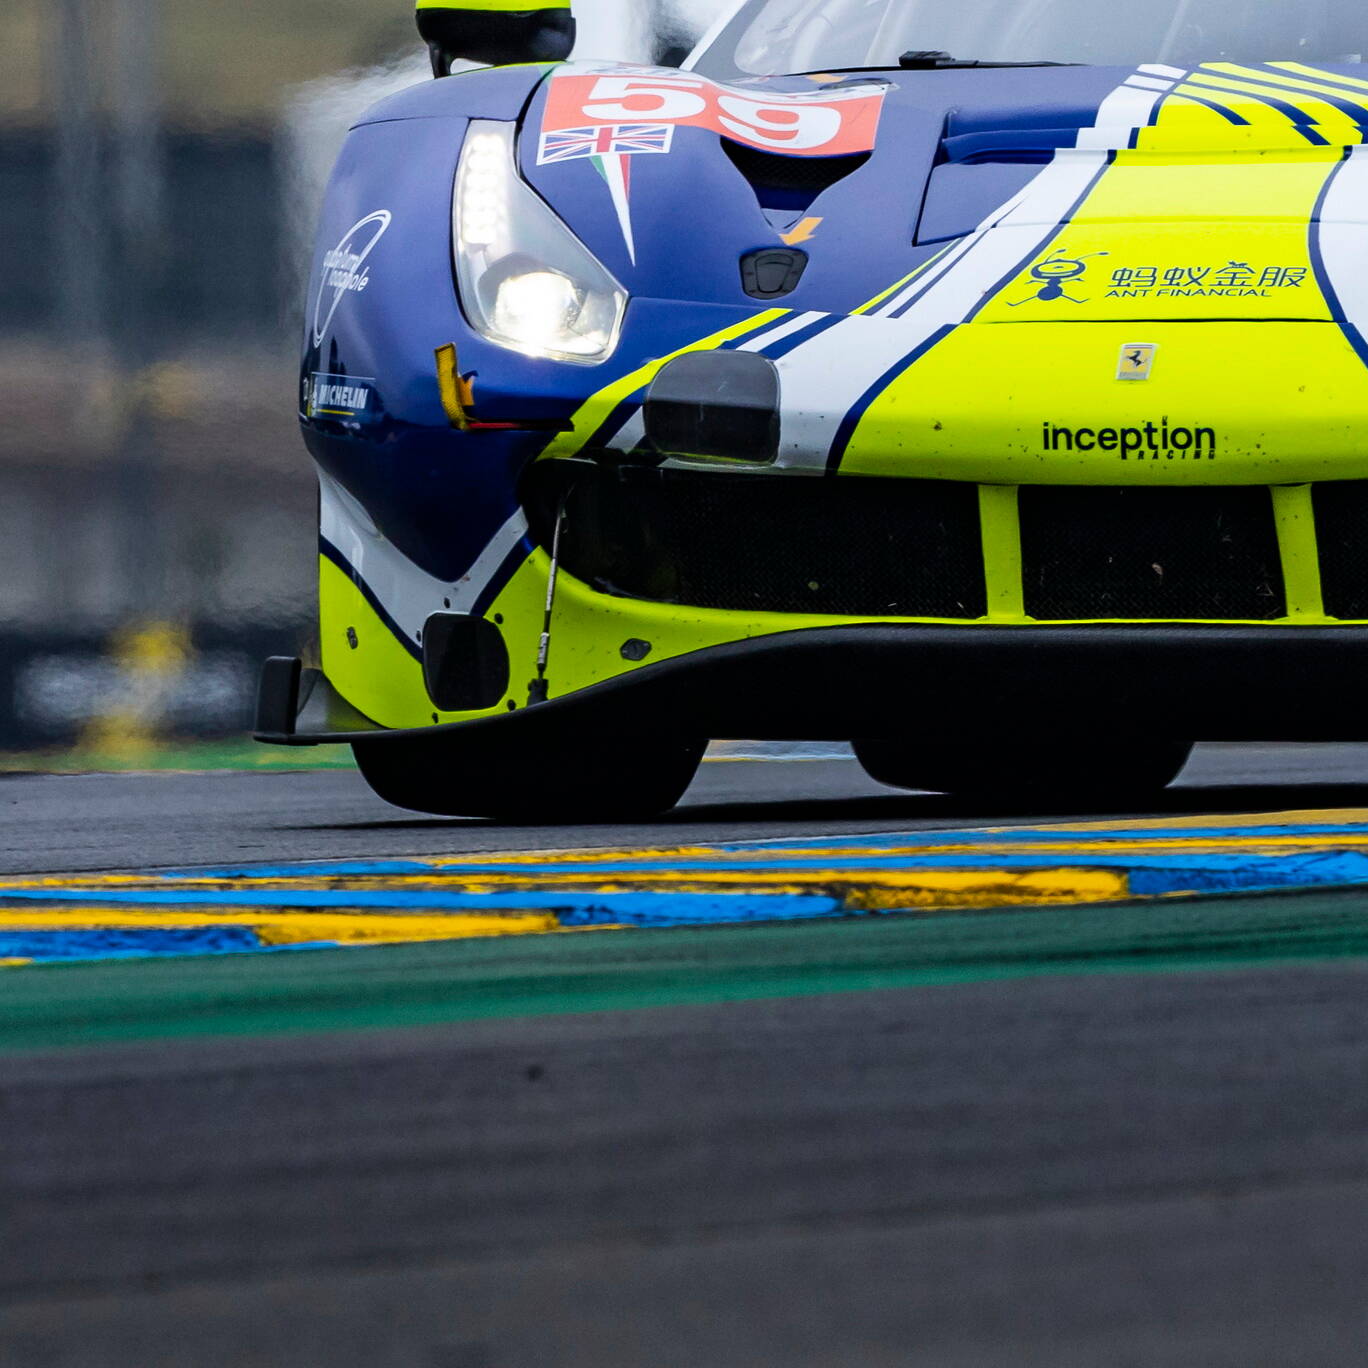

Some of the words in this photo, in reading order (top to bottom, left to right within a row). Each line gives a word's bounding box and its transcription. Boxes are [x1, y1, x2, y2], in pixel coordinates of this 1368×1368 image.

[581, 77, 842, 149] 59
[1107, 261, 1307, 288] 蚂蚁金服
[1105, 289, 1152, 298] ANT
[1156, 288, 1272, 298] FINANCIAL
[318, 384, 369, 409] MICHELIN
[1042, 421, 1216, 460] inception
[1137, 449, 1216, 460] RACING
